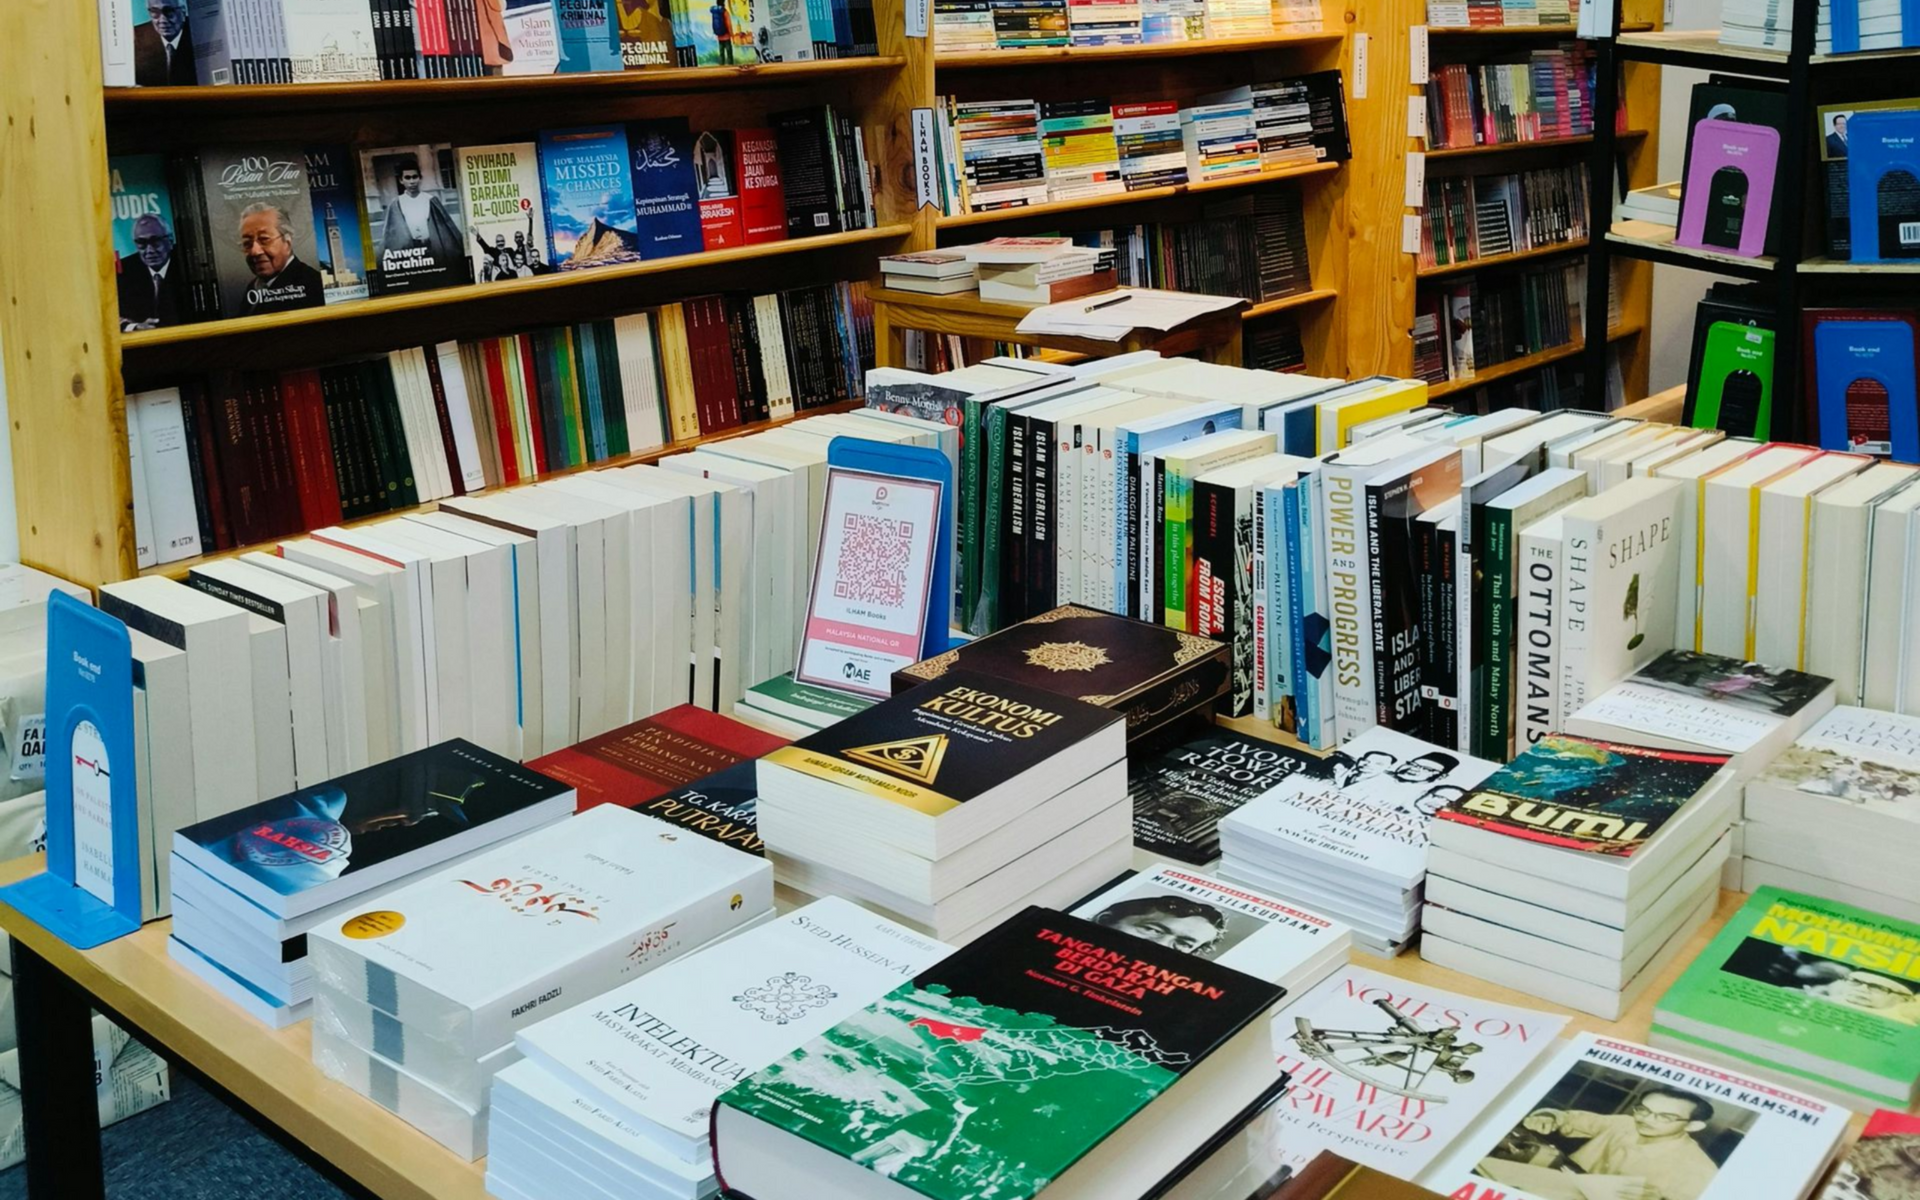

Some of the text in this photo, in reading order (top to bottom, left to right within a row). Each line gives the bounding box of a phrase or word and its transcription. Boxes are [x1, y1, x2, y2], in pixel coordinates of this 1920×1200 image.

[520, 18, 550, 30] Islam
[560, 10, 607, 20] KRIMINAL
[518, 39, 554, 48] Muslim
[620, 41, 669, 55] PEGUAM
[621, 54, 670, 66] KRIMINAL
[466, 152, 517, 171] SYUHADA
[554, 154, 619, 167] HOW MALAYSIA
[742, 139, 778, 154] KEGANASAN
[920, 112, 931, 198] ILHAM BOOKS
[218, 164, 264, 188] Pesan
[242, 156, 270, 172] 100
[468, 168, 512, 186] DI BUMI
[555, 162, 621, 182] MISSED
[744, 166, 765, 178] JALAN
[470, 184, 520, 202] BARAKAH
[565, 176, 622, 193] CHANCES
[755, 174, 779, 190] SYURGA
[472, 200, 520, 218] AL-QUDS
[636, 203, 687, 217] MUHAMMAD
[382, 246, 428, 260] Anwar
[382, 255, 435, 272] Ibrahim
[884, 390, 910, 406] Benny
[1012, 426, 1023, 535] ISLAM IN LIBERALISM
[1035, 431, 1046, 541] ISLAM IN LIBERALISM
[1256, 491, 1264, 515] NOAM
[1328, 476, 1355, 555] POWER
[1129, 524, 1136, 535] IN
[1256, 516, 1264, 556] CHOMSKY
[1609, 517, 1670, 568] SHAPE
[1170, 550, 1180, 571] place
[1332, 558, 1356, 569] AND
[1530, 547, 1554, 560] THE
[1199, 558, 1212, 600] FROM
[1368, 494, 1384, 652] ISLAM AND THE LIBERAL STATE
[1568, 538, 1588, 632] SHAPE
[208, 583, 276, 615] SUNDAY TIMES BESTSELLER
[1170, 573, 1179, 606] together
[1212, 576, 1225, 632] ESCAPE
[1274, 572, 1282, 628] PALESTINE
[846, 608, 886, 620] ILHAM Books
[1332, 572, 1360, 688] PROGRESS
[826, 628, 900, 648] MALAYSIA NATIONAL QR
[1256, 605, 1264, 692] GLOBAL DISCONTENTS
[1392, 624, 1420, 656] ISLA
[1526, 562, 1553, 744] OTTOMANS
[72, 650, 90, 668] Book
[89, 661, 102, 676] end
[842, 662, 872, 680] MAE
[1393, 652, 1415, 675] AND
[1490, 574, 1502, 737] Thai South and Malay North
[1377, 660, 1385, 690] STEPHEN
[918, 695, 1044, 741] KULTUS
[944, 686, 1064, 727] EKONOMI
[1395, 688, 1422, 720] STA
[24, 728, 39, 741] FA
[633, 731, 662, 745] DAN
[645, 726, 740, 764] PENDIDIKAN
[622, 736, 718, 774] PEMBANGUNAN
[1178, 752, 1273, 790] REFOR
[1206, 746, 1290, 782] TOWE
[1224, 741, 1308, 773] IVORY
[803, 756, 918, 799] AHMAD MOHAMAD NOOR
[1158, 768, 1202, 788] Higher
[1200, 774, 1262, 798] Vision for
[680, 790, 708, 806] TG.
[1320, 790, 1427, 830] KEMISKINAN
[1280, 798, 1425, 848] JALAN KEPULIHANNYA
[1293, 791, 1430, 843] MELAYU DAN
[1462, 792, 1648, 841] BUMI
[252, 825, 334, 861] RAHSIA
[1276, 826, 1370, 861] ANWAR IBRAHIM
[1152, 874, 1320, 936] MIRANTI SILASUDJANA
[791, 914, 900, 970] SYED HUSSEIN
[1035, 928, 1226, 1002] TANGAN-TANGAN
[1053, 960, 1149, 1000] DI GAZA
[1054, 948, 1179, 996] BERDARAH
[510, 986, 564, 1020] FAKHRI FADZLI
[1024, 968, 1143, 1016] Norman Finkelstein
[1331, 978, 1541, 1043] NOTES ON
[591, 1010, 670, 1060] MASYARAKAT
[622, 1081, 648, 1101] ALATAS
[1585, 1046, 1685, 1083] MUHAMMAD
[1736, 1090, 1821, 1126] KAMSANI
[613, 1118, 641, 1138] ALATAS
[1306, 1120, 1409, 1158] Perspective
